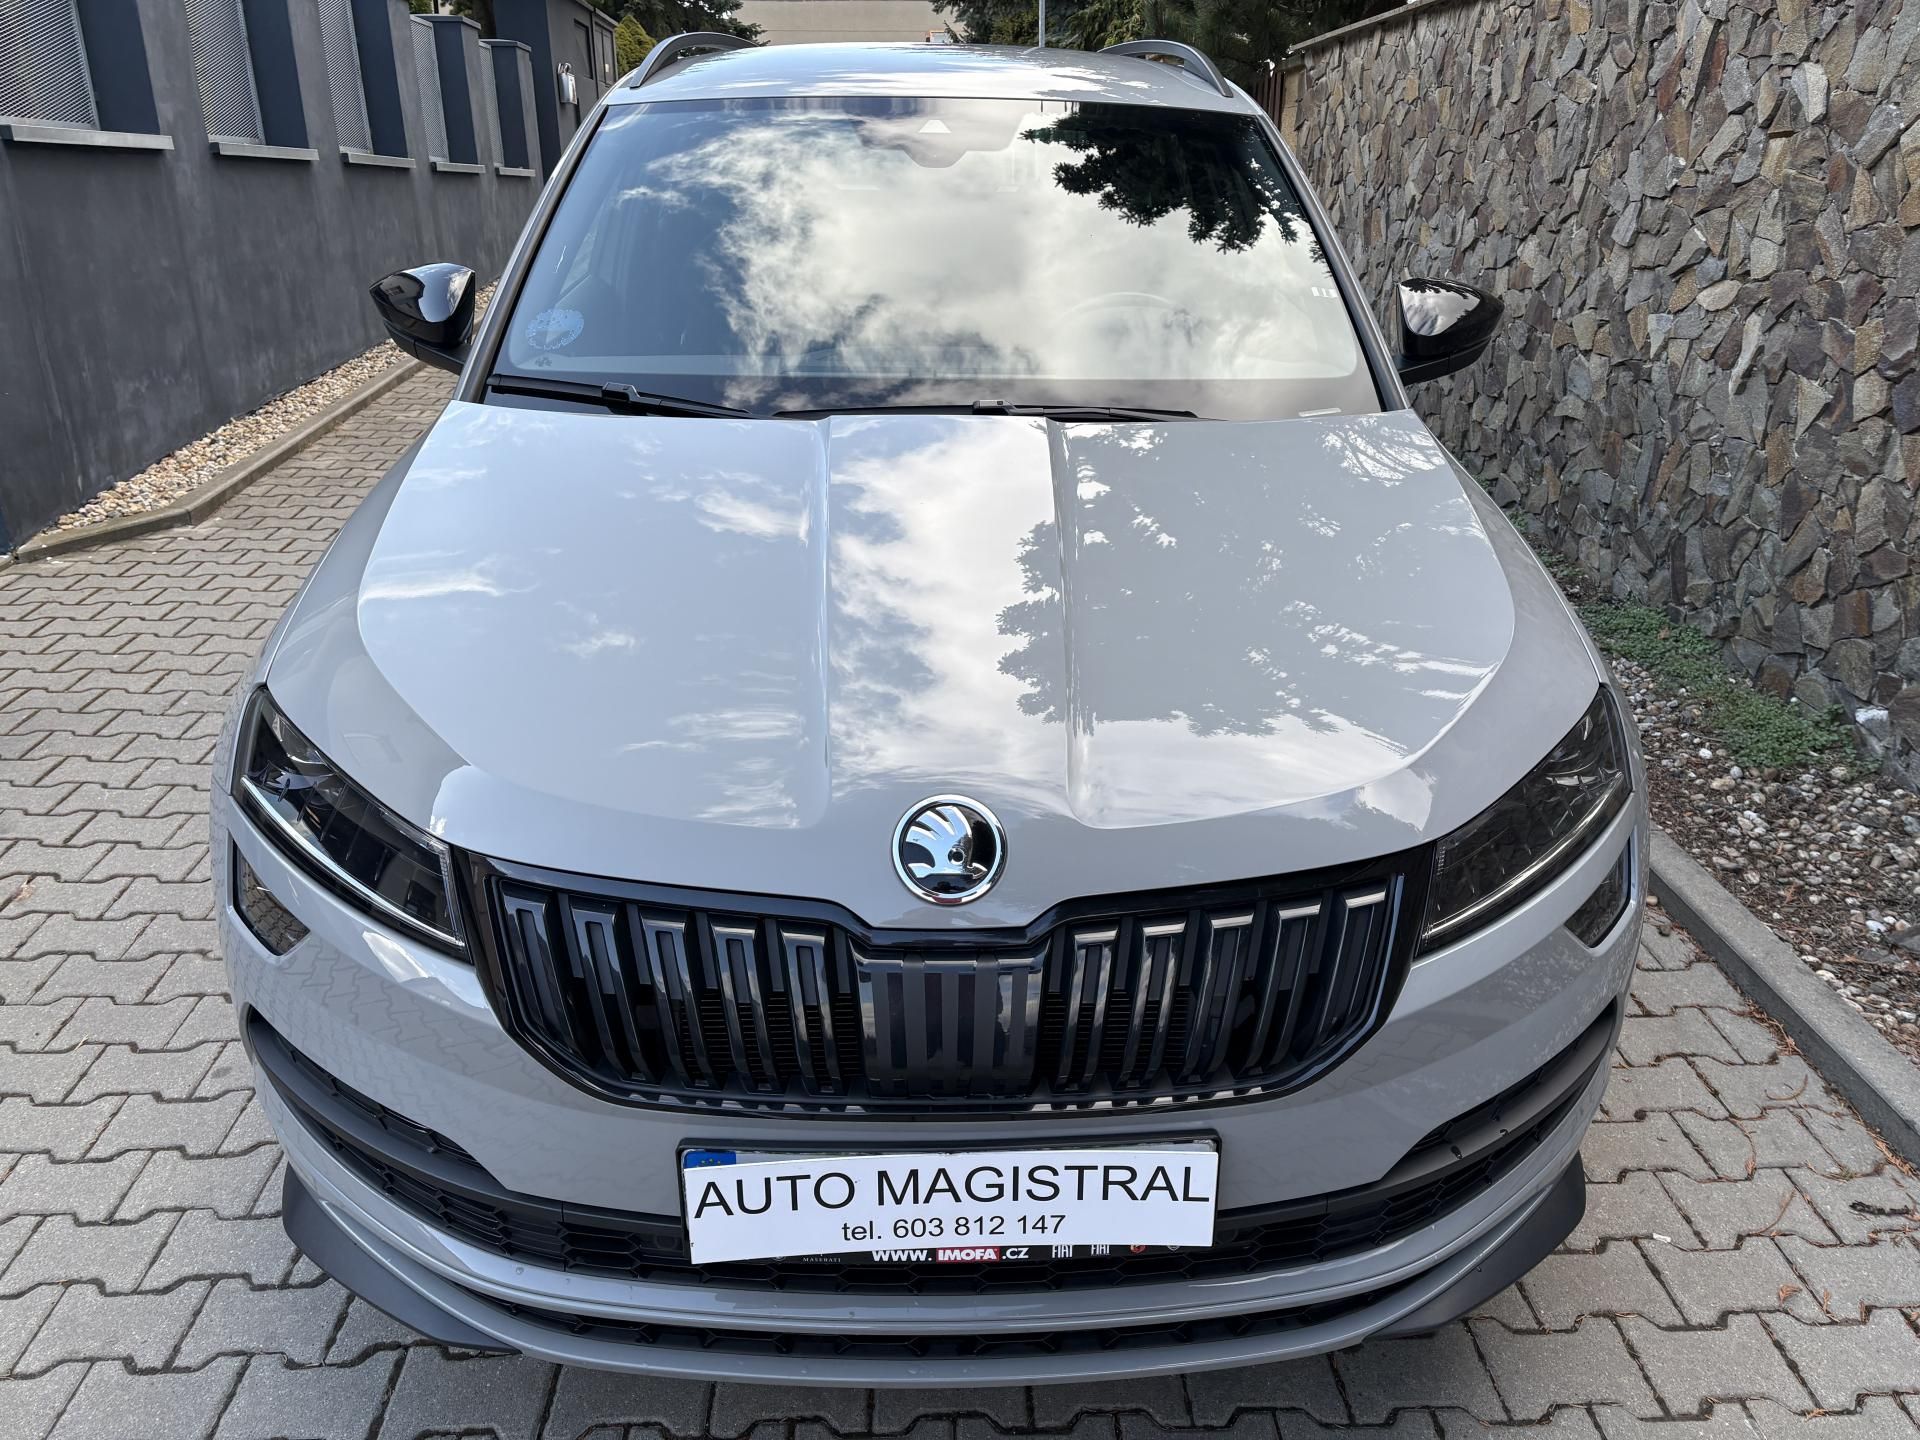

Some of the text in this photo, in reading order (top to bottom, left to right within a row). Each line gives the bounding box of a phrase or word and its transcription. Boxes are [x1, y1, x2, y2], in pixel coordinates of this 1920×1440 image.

[694, 1164, 1210, 1219] AUTO MAGISTRAL
[842, 1214, 1066, 1241] tel. 603 812 147
[937, 1248, 998, 1261] IMOFA
[1051, 1244, 1073, 1258] FIAT
[1090, 1244, 1110, 1255] FIAT
